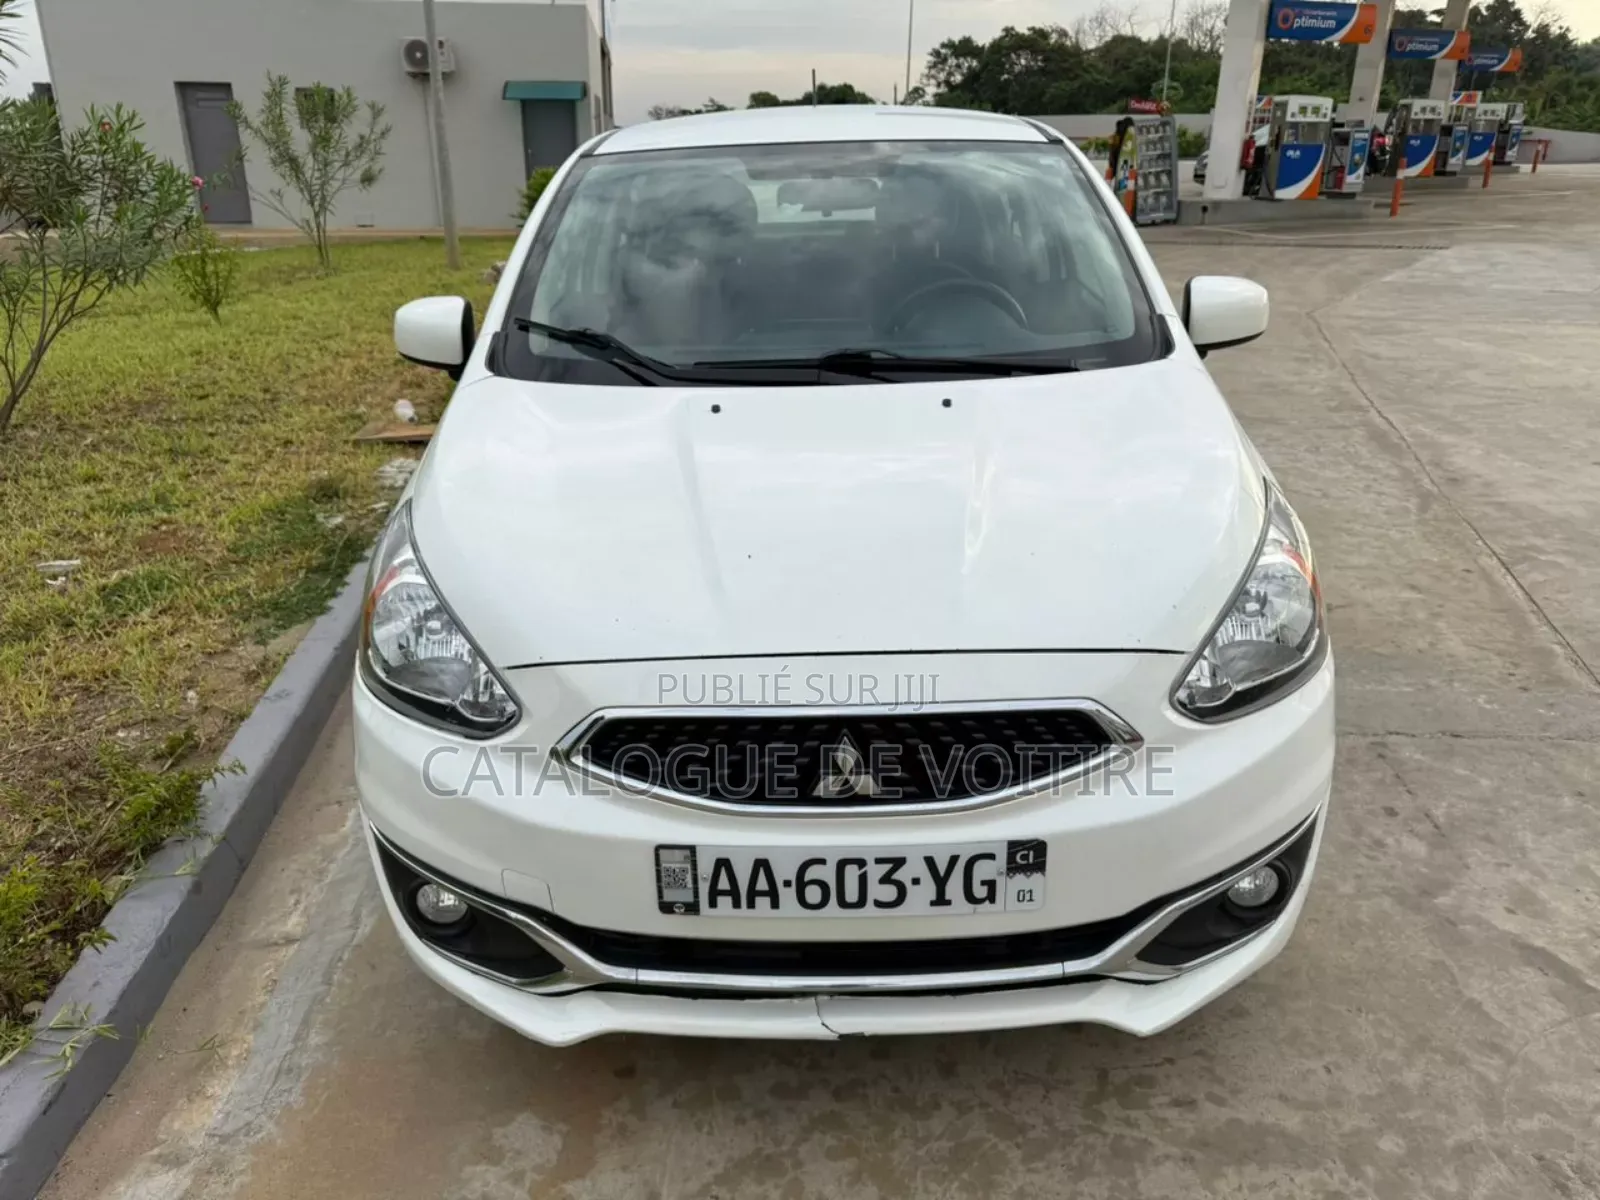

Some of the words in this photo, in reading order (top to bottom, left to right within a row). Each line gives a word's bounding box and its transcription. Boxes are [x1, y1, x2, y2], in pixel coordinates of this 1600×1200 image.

[1277, 8, 1336, 30] Optimium
[1016, 850, 1034, 864] CI
[1017, 889, 1034, 903] 01
